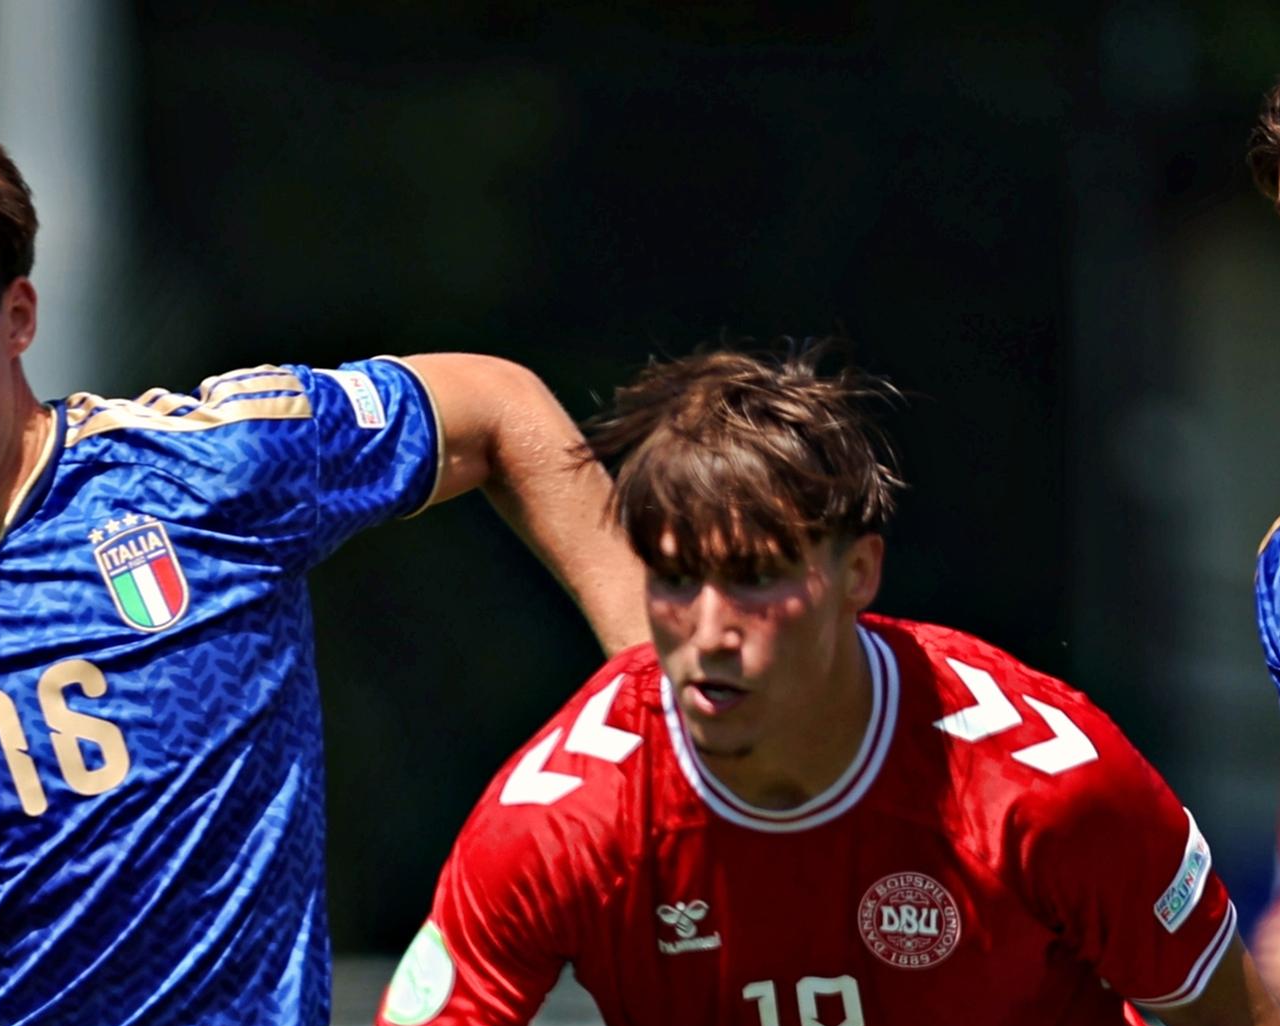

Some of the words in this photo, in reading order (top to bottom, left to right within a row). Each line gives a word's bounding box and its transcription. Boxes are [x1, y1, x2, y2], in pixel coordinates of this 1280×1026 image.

[102, 531, 164, 571] ITALIA
[861, 897, 886, 953] DANSK
[933, 905, 958, 957] UNION
[879, 904, 939, 936] DBU
[890, 952, 931, 966] 1889
